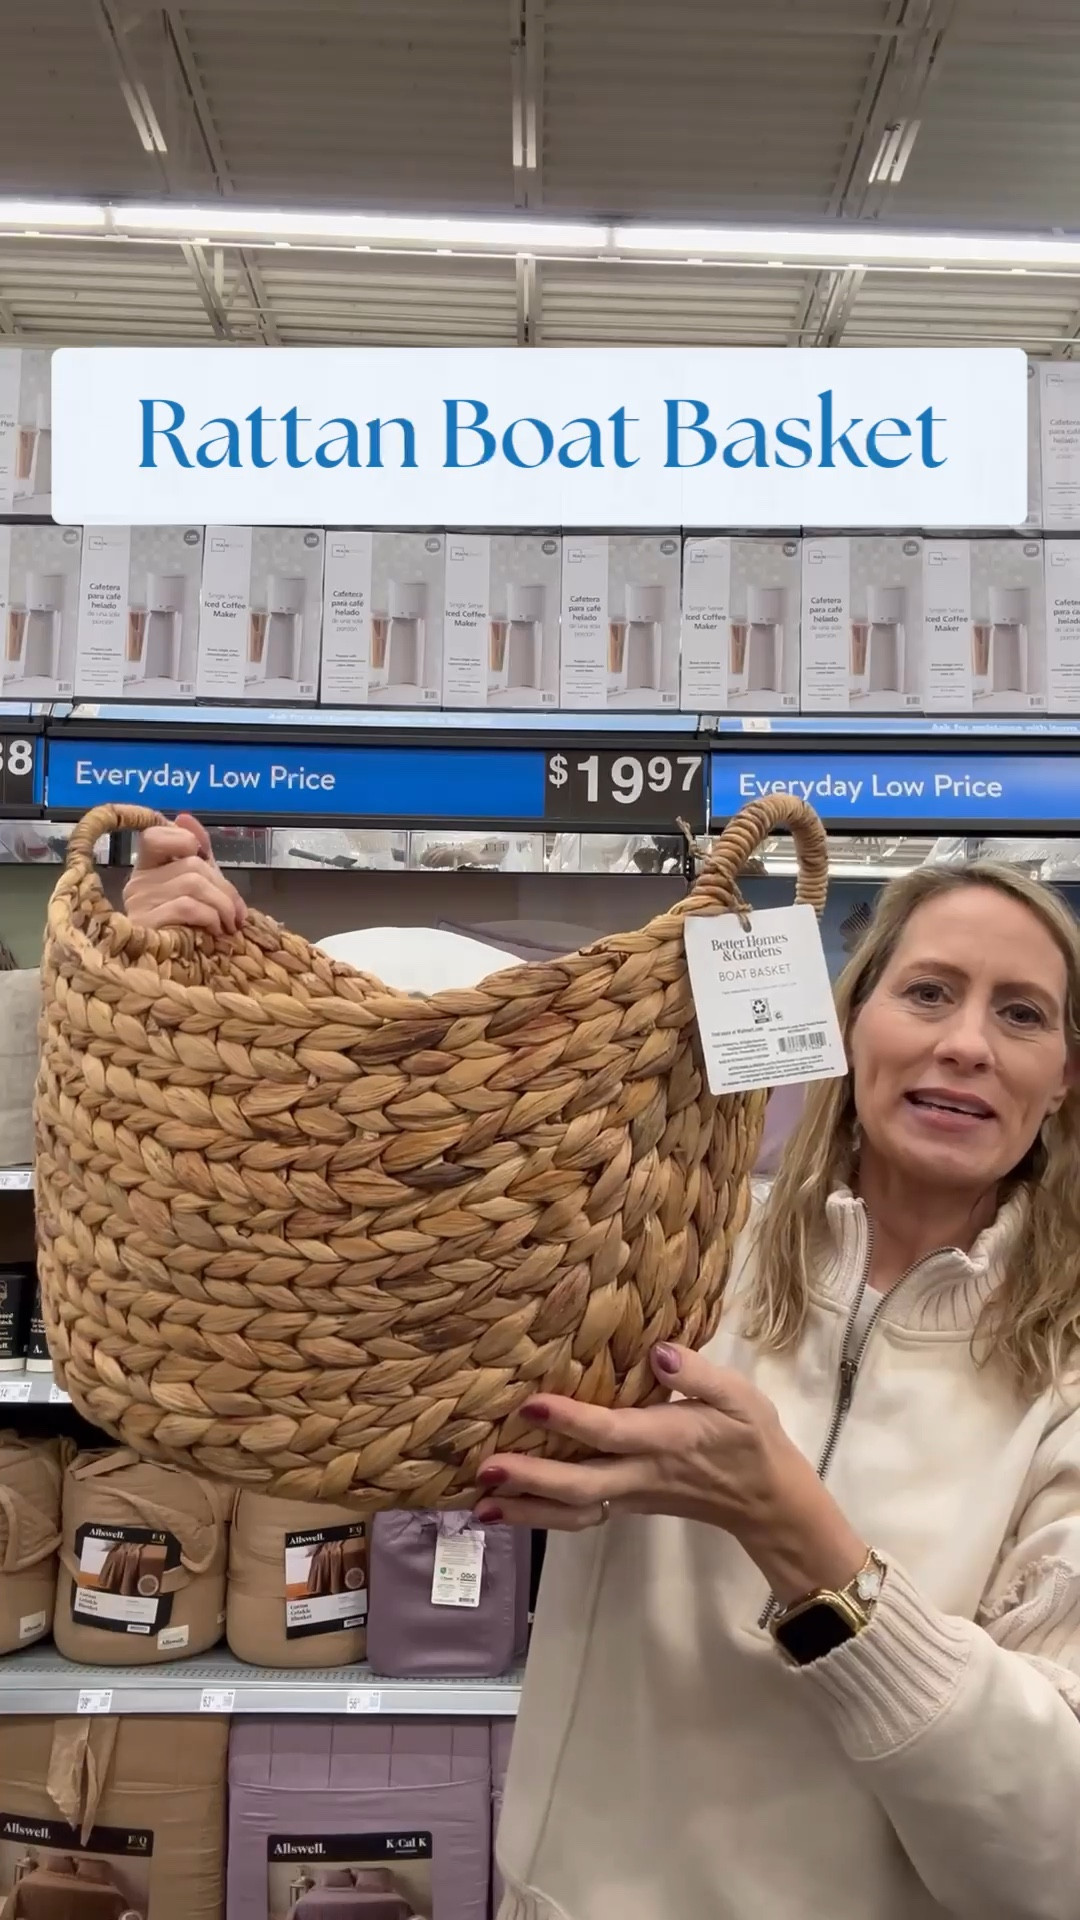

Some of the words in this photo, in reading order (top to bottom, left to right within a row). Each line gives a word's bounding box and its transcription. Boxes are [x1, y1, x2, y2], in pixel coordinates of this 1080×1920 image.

[213, 610, 236, 618] Maker
[222, 601, 246, 609] Coffee
[446, 610, 461, 618] Iced
[462, 610, 486, 618] Coffee
[694, 622, 718, 630] Maker
[0, 739, 33, 776] 8
[76, 760, 201, 794] Everyday
[208, 763, 261, 789] Low
[270, 764, 336, 791] Price
[739, 774, 864, 804] Everyday
[872, 774, 924, 798] Low
[934, 774, 1003, 798] Price
[712, 936, 745, 952] Better
[746, 933, 789, 948] Homes
[718, 968, 746, 982] BOAT
[750, 963, 792, 978] BASKET
[4, 1822, 52, 1840] Allswell.
[274, 1842, 326, 1855] Allswell.
